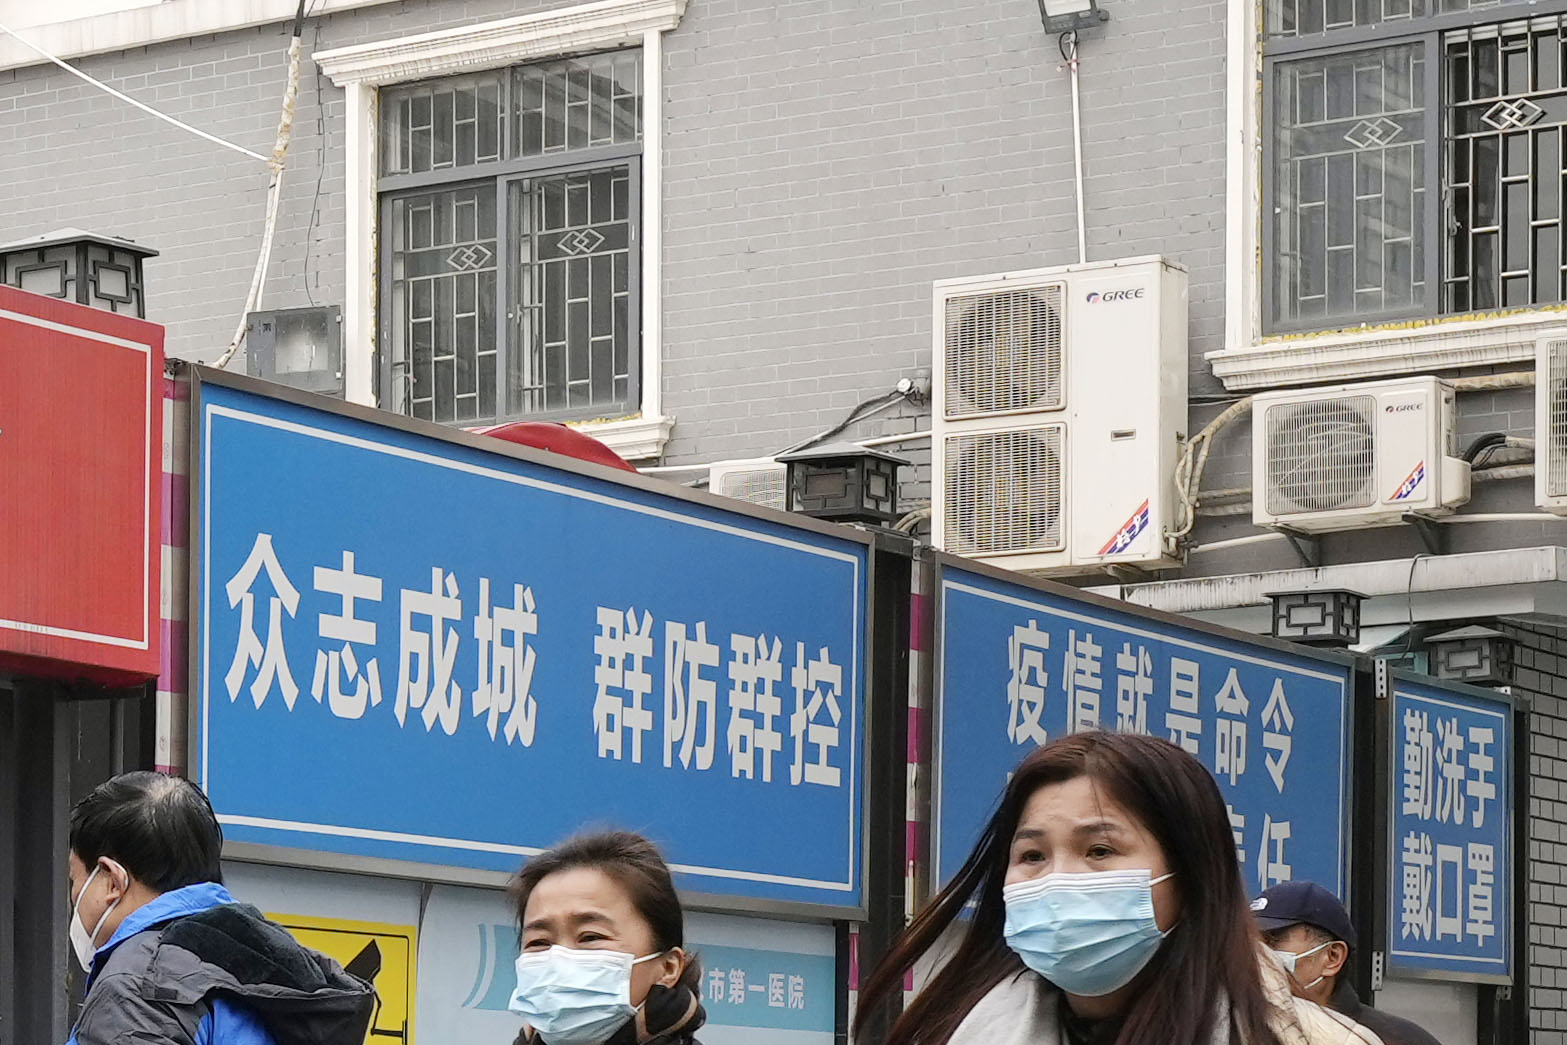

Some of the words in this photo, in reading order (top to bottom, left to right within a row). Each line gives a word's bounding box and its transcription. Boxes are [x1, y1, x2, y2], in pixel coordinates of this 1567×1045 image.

[1102, 287, 1145, 302] GREE
[224, 532, 539, 748] 众志成城
[592, 605, 843, 788] 群防群控
[1006, 618, 1295, 794] 疫情就是命令
[1402, 708, 1497, 829] 勤洗手
[1401, 830, 1496, 947] 戴口罩
[699, 967, 805, 1010] 市第一医院
